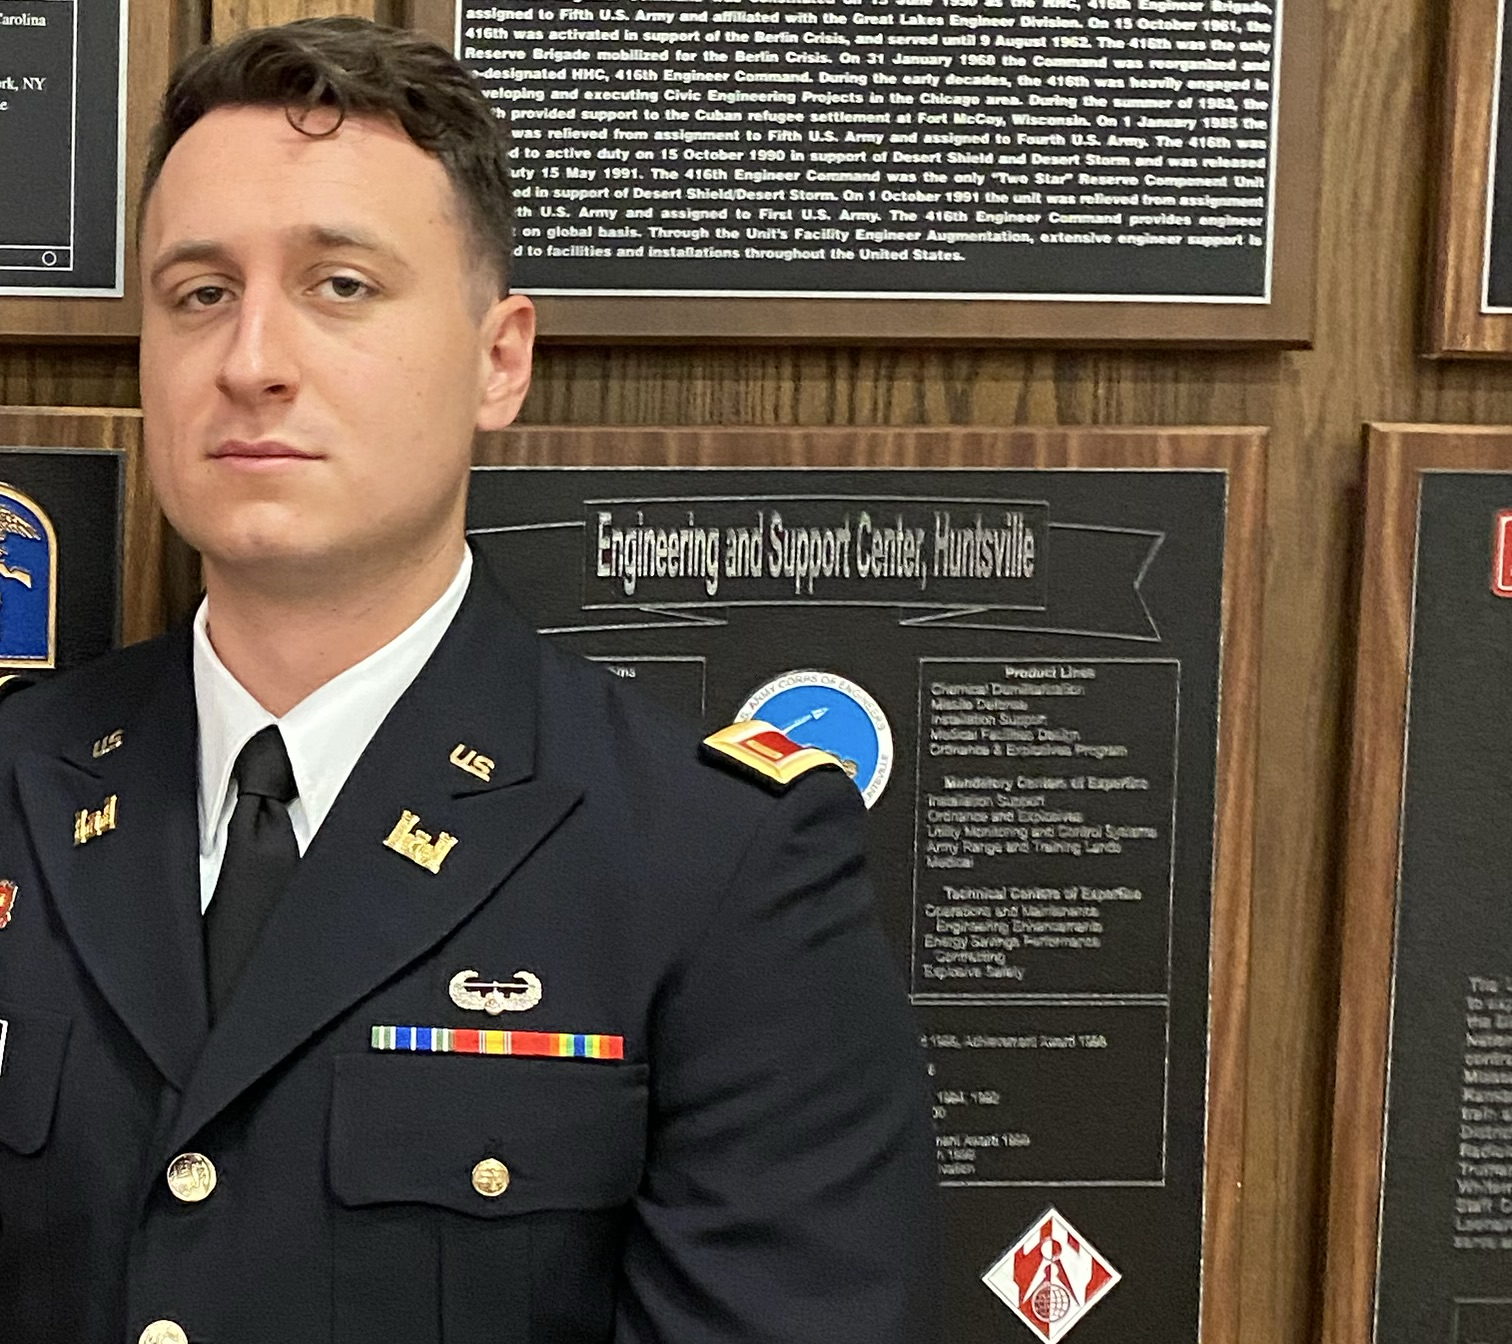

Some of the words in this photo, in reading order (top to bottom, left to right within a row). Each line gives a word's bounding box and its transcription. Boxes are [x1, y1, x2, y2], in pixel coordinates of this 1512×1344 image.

[597, 510, 720, 596] Engineering
[725, 510, 764, 578] and
[768, 510, 851, 595] Support
[856, 510, 927, 591] Center,
[934, 510, 1036, 579] Huntsville
